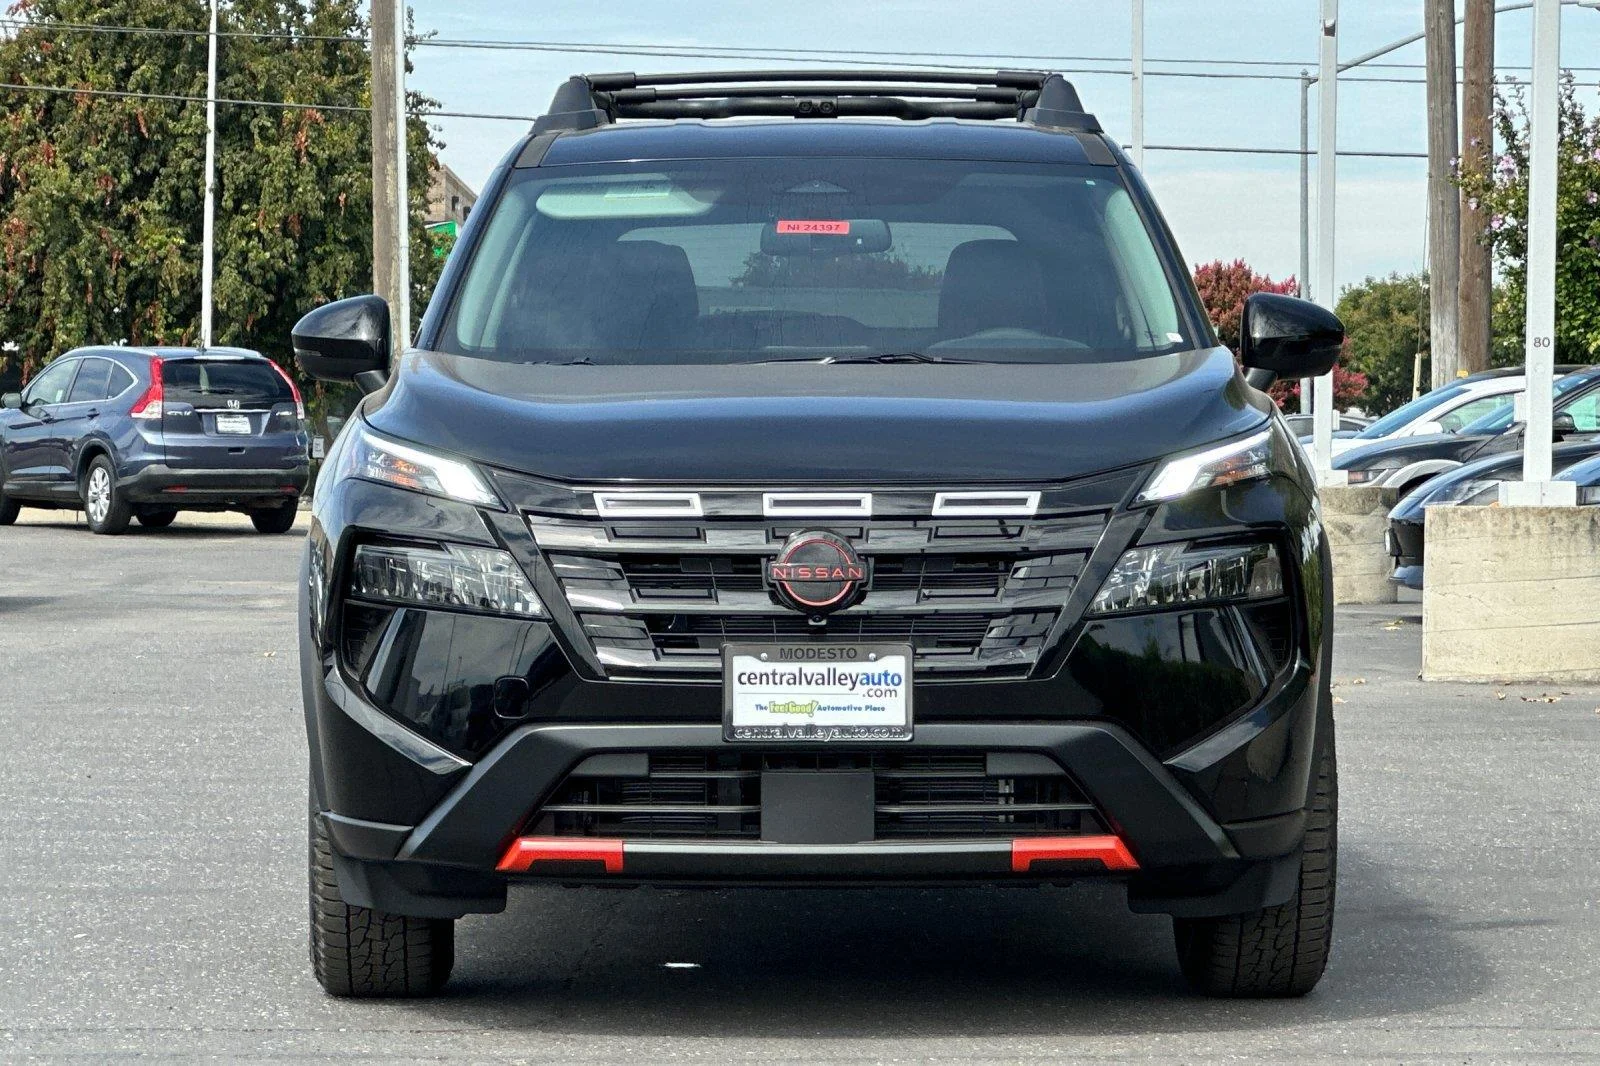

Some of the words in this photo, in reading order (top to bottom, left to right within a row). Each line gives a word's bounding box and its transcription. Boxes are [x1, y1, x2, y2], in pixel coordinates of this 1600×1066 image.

[1533, 337, 1550, 348] 80
[773, 567, 862, 578] NISSAN
[779, 647, 858, 660] MODESTO
[737, 667, 902, 691] centralvalleyauto
[862, 687, 898, 698] .com
[817, 704, 862, 712] Automotive
[864, 704, 885, 712] Place
